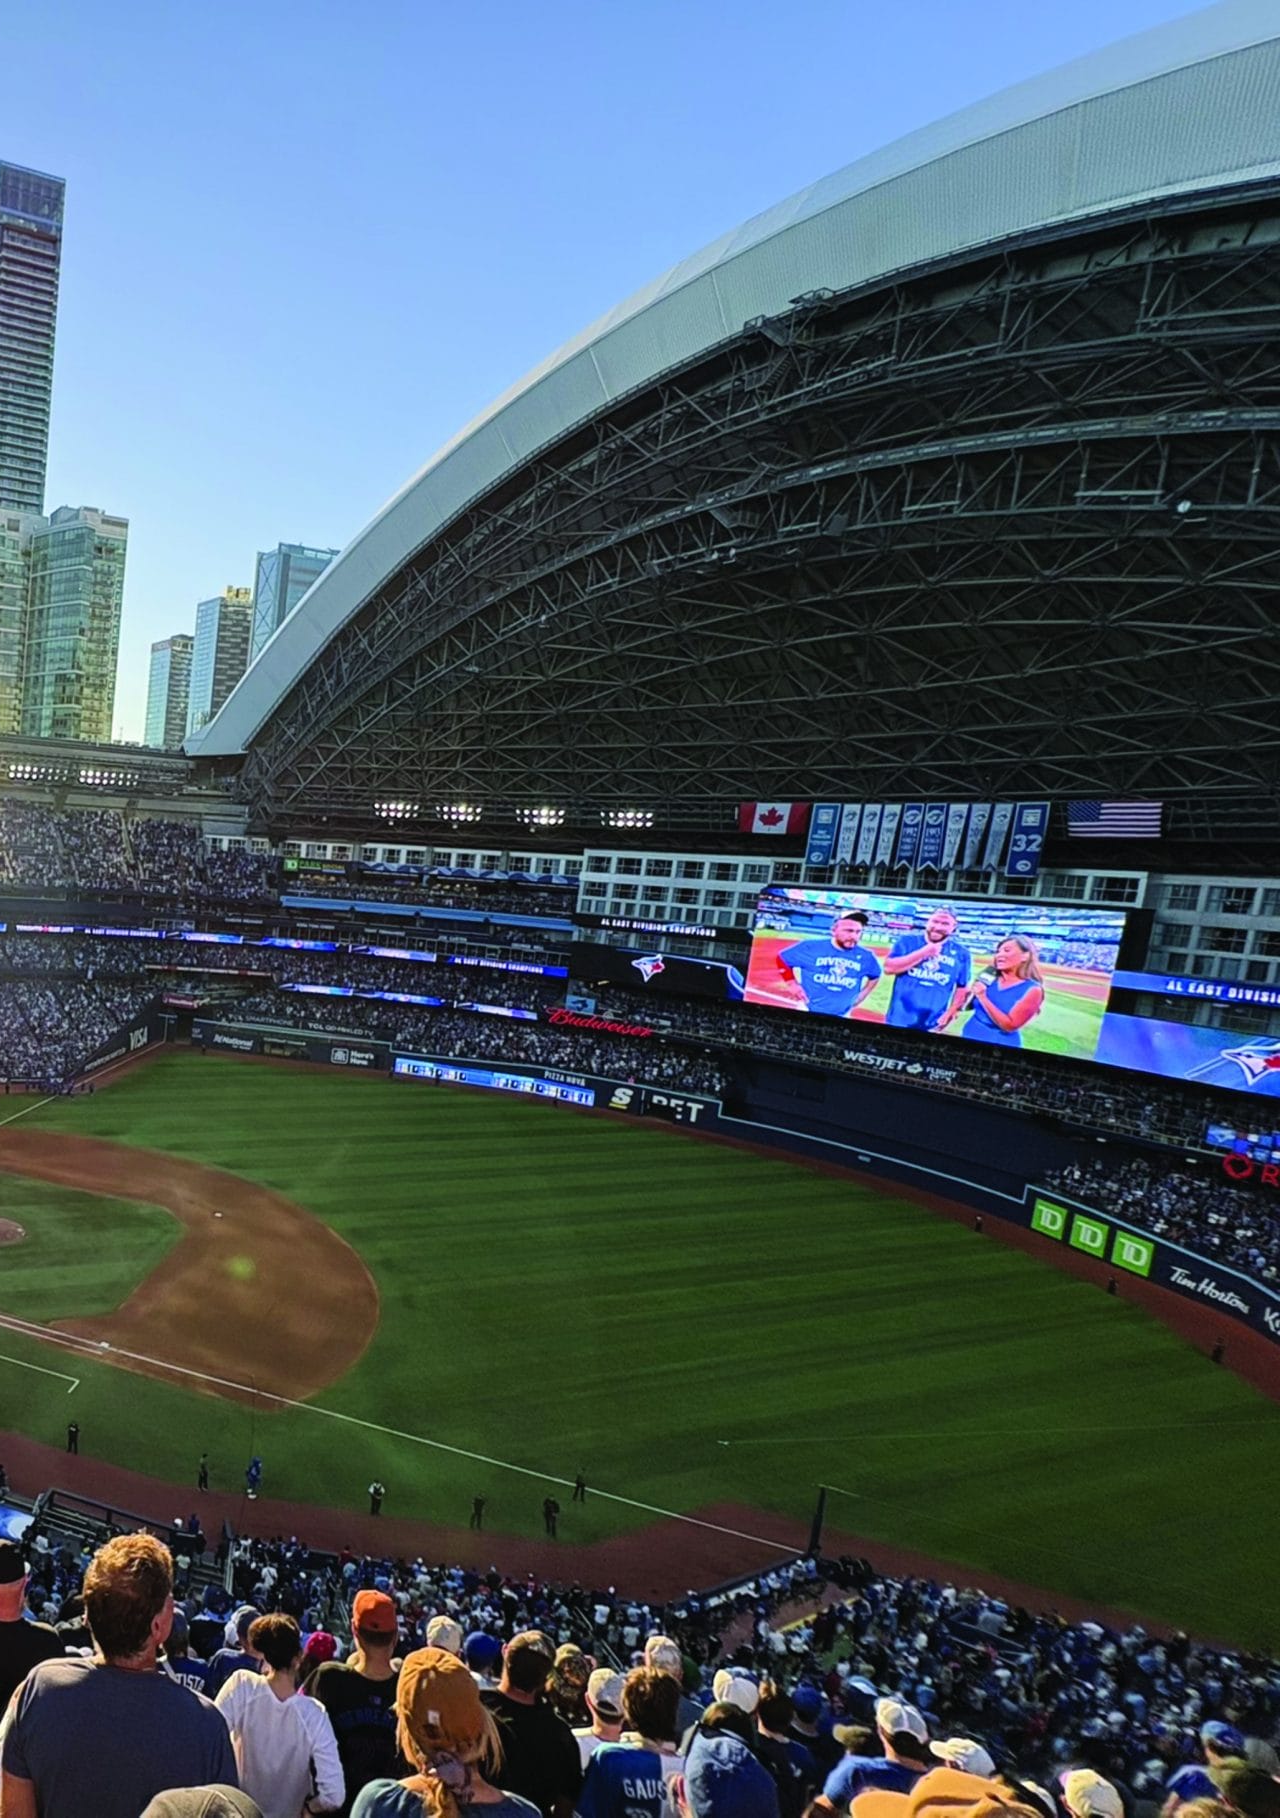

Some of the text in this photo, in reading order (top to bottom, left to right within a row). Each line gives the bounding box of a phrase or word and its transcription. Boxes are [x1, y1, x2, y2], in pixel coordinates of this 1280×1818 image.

[1012, 834, 1043, 852] 32
[601, 918, 716, 937] AL EAST DIVISION CHAMPIONS
[815, 956, 861, 971] DIVISION
[813, 973, 858, 988] CHAMPS
[1166, 980, 1183, 991] AL
[1188, 982, 1225, 996] EAST
[308, 1022, 324, 1031] TCL
[545, 1007, 652, 1037] Budweiser
[129, 1026, 149, 1051] VISA
[223, 1036, 254, 1049] National
[843, 1049, 907, 1071] WESTJET
[544, 1070, 586, 1087] PIZZA NOVA
[926, 1066, 957, 1078] FLIGHT
[611, 1087, 634, 1105] S
[1037, 1203, 1064, 1232] TD
[1074, 1221, 1104, 1249] TD
[1115, 1237, 1149, 1267] TD
[1169, 1266, 1250, 1314] Tim Hortons
